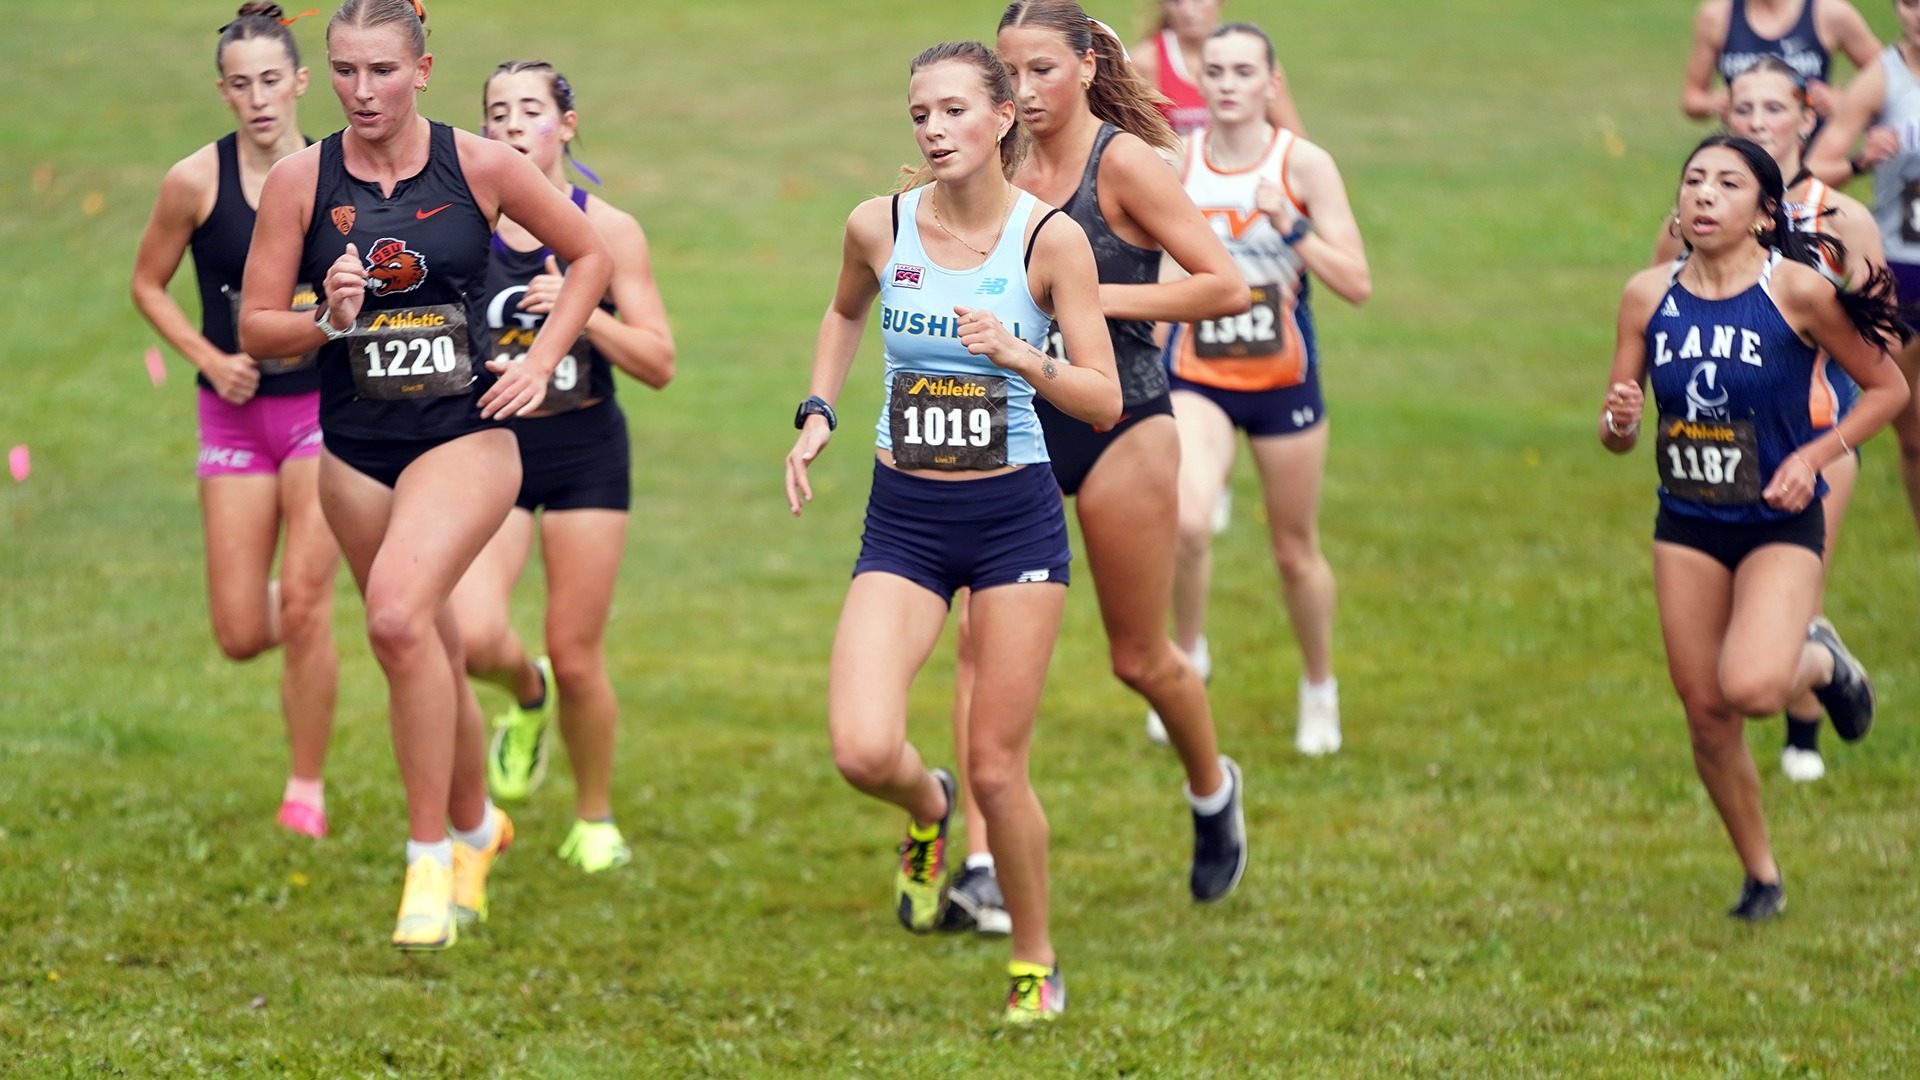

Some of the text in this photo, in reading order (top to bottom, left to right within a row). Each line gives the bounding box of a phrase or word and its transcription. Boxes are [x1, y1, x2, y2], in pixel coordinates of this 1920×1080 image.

[373, 244, 401, 262] OSU
[367, 311, 445, 331] Athletic
[882, 306, 1028, 342] BUSHL
[1199, 305, 1276, 344] 1342
[364, 335, 456, 377] 1220
[1654, 324, 1762, 368] LANE
[908, 377, 986, 396] Athletic
[904, 406, 991, 447] 1019
[1669, 420, 1735, 442] Athletic
[1667, 443, 1742, 483] 1187
